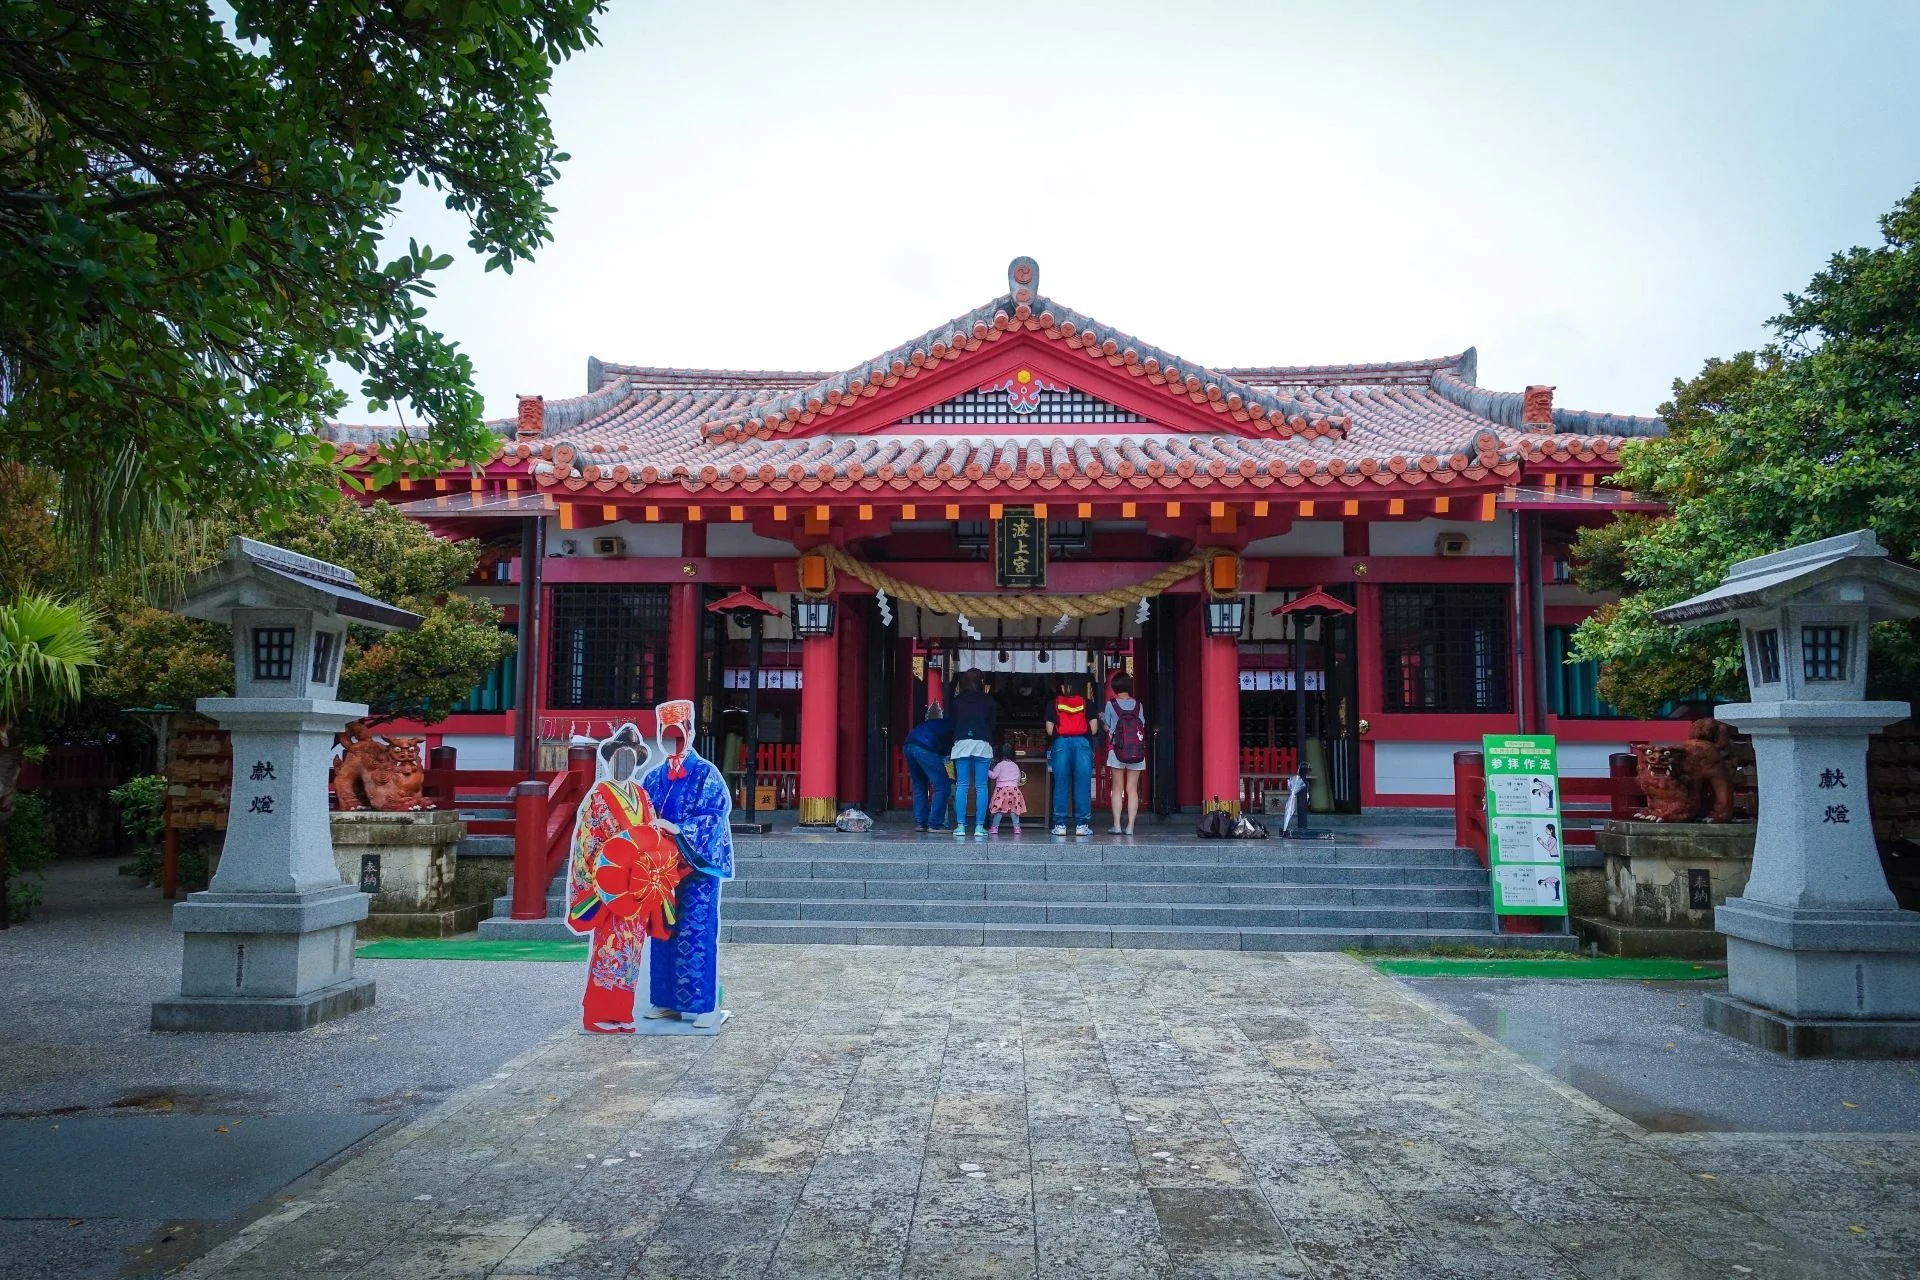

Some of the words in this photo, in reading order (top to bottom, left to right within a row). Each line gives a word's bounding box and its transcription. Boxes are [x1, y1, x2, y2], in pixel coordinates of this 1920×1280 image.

[1012, 518, 1030, 574] 波上宮
[1491, 758, 1551, 770] 参拝作法
[363, 860, 378, 887] 奉納
